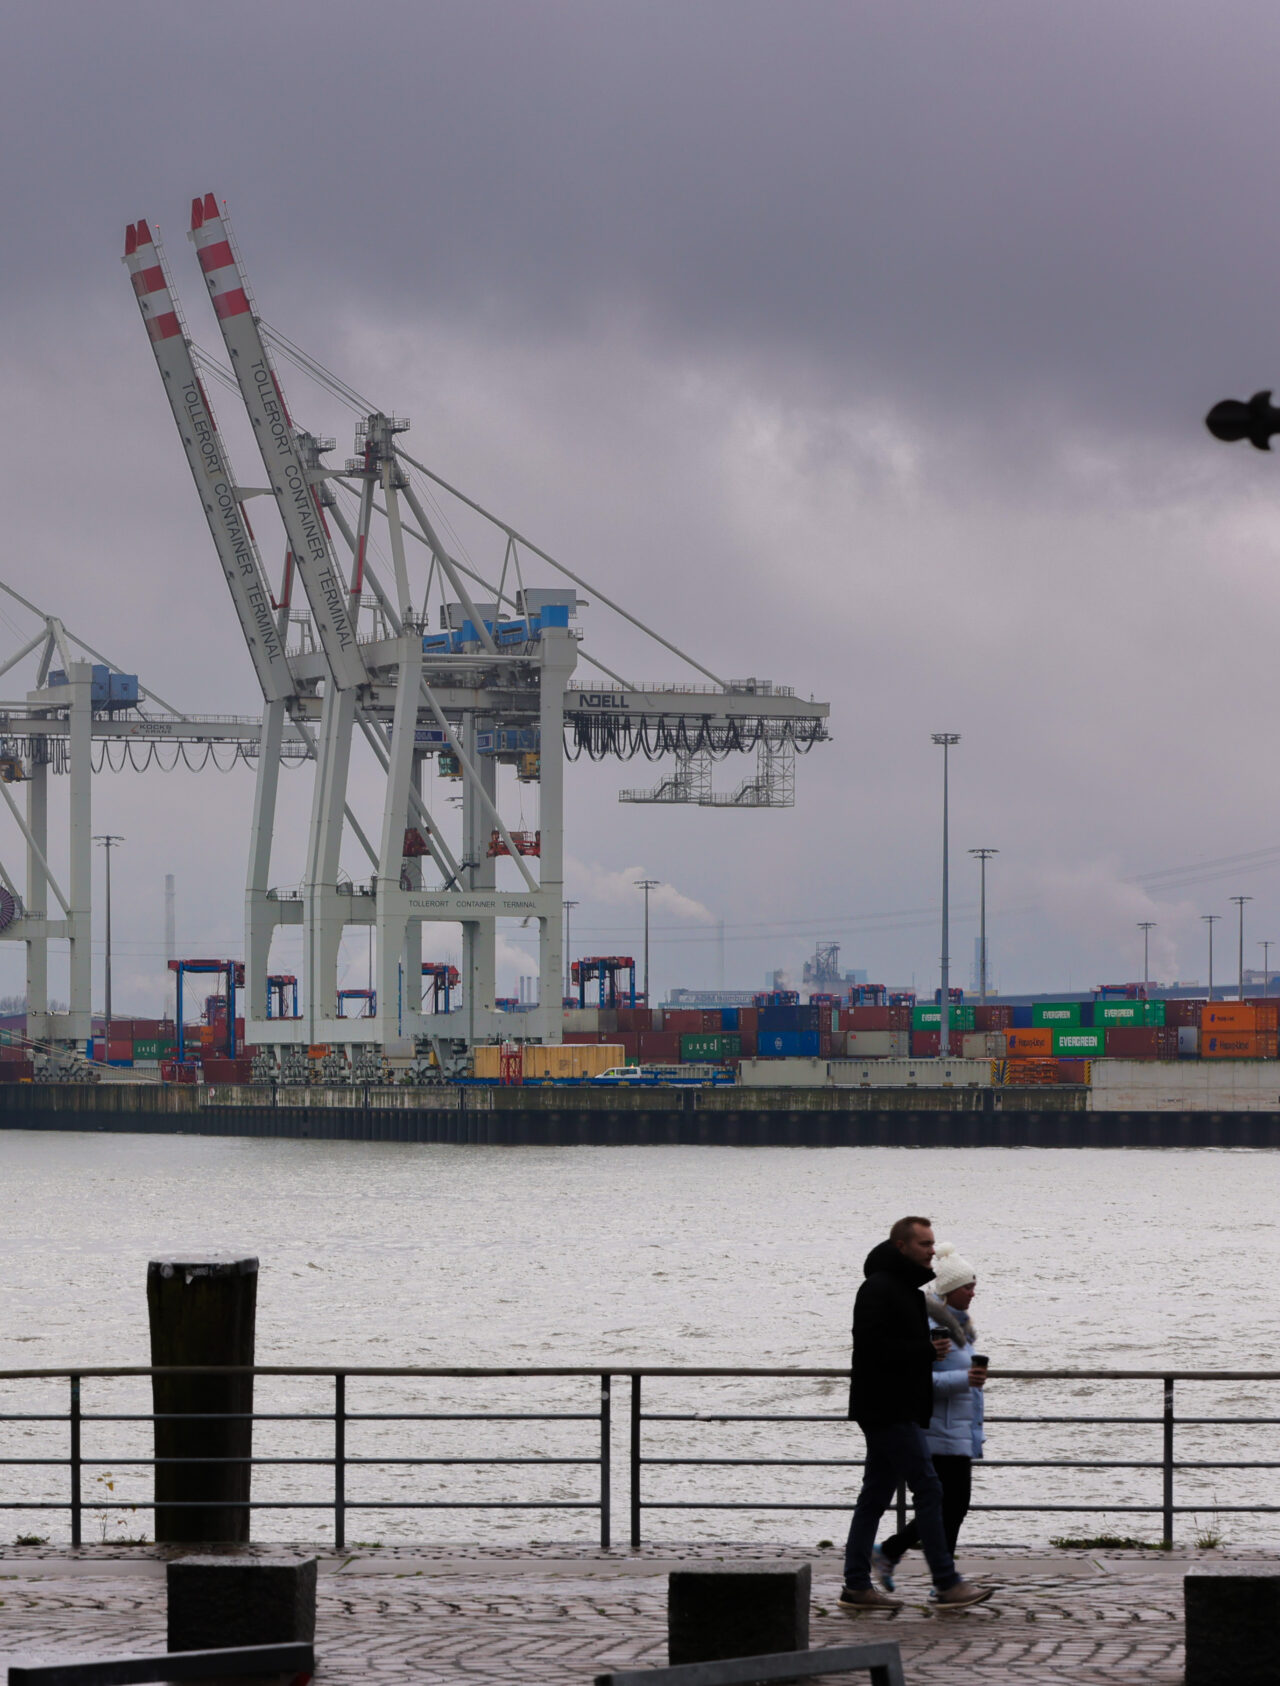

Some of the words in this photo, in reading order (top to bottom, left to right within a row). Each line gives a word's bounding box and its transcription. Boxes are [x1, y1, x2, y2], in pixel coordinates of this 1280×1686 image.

[250, 359, 293, 456] TOLLERORT
[284, 464, 325, 562] CONTAINER
[318, 567, 353, 653] TERMINAL
[182, 381, 222, 474] TOLLERORT
[214, 483, 254, 577] CONTAINER
[246, 582, 281, 665] TERMINAL
[579, 694, 629, 708] NOELL
[1043, 1010, 1071, 1019] EVERGREEN
[1104, 1009, 1135, 1017] EVERGREEN
[1059, 1036, 1098, 1047] EVERGREEN
